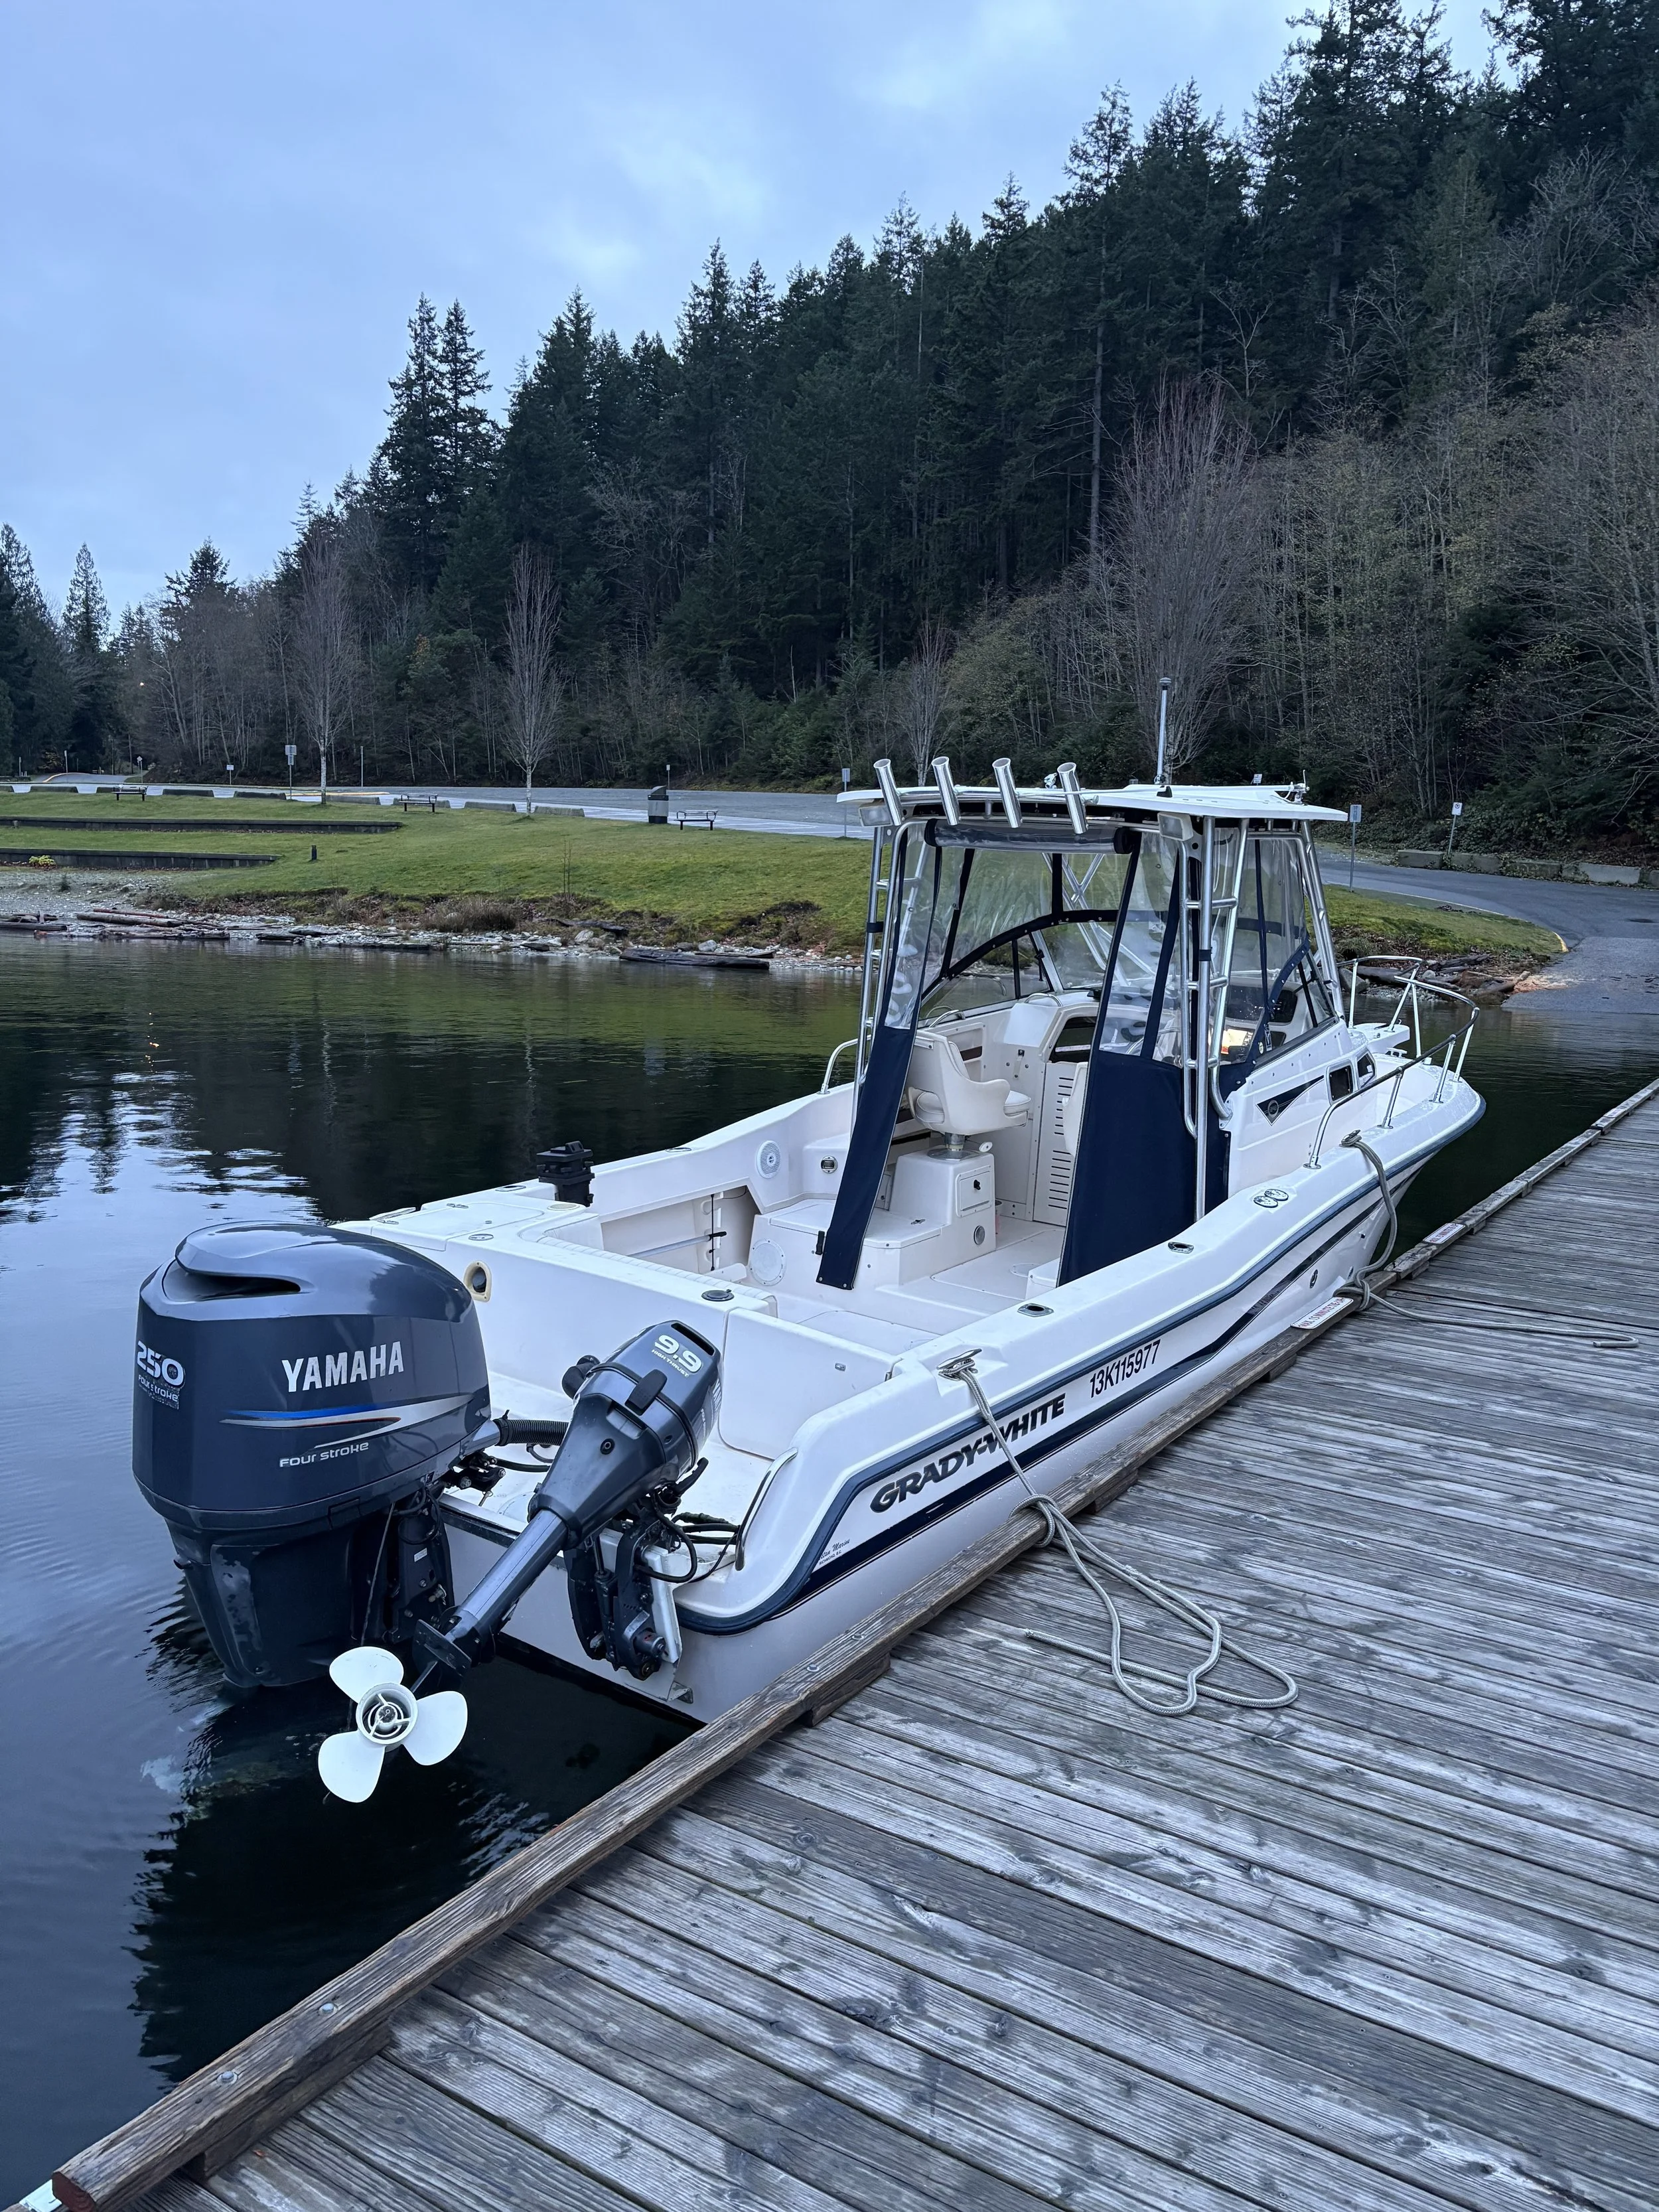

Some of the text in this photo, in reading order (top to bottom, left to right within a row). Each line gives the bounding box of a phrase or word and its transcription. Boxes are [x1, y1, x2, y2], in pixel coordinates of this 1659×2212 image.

[137, 1341, 184, 1386] 250
[281, 1341, 404, 1392] YAMAHA
[652, 1349, 689, 1377] HIGH THRUST
[654, 1335, 702, 1373] 9.9
[1090, 1339, 1161, 1398] 13K115977
[870, 1393, 1066, 1513] GRADY-WHITE
